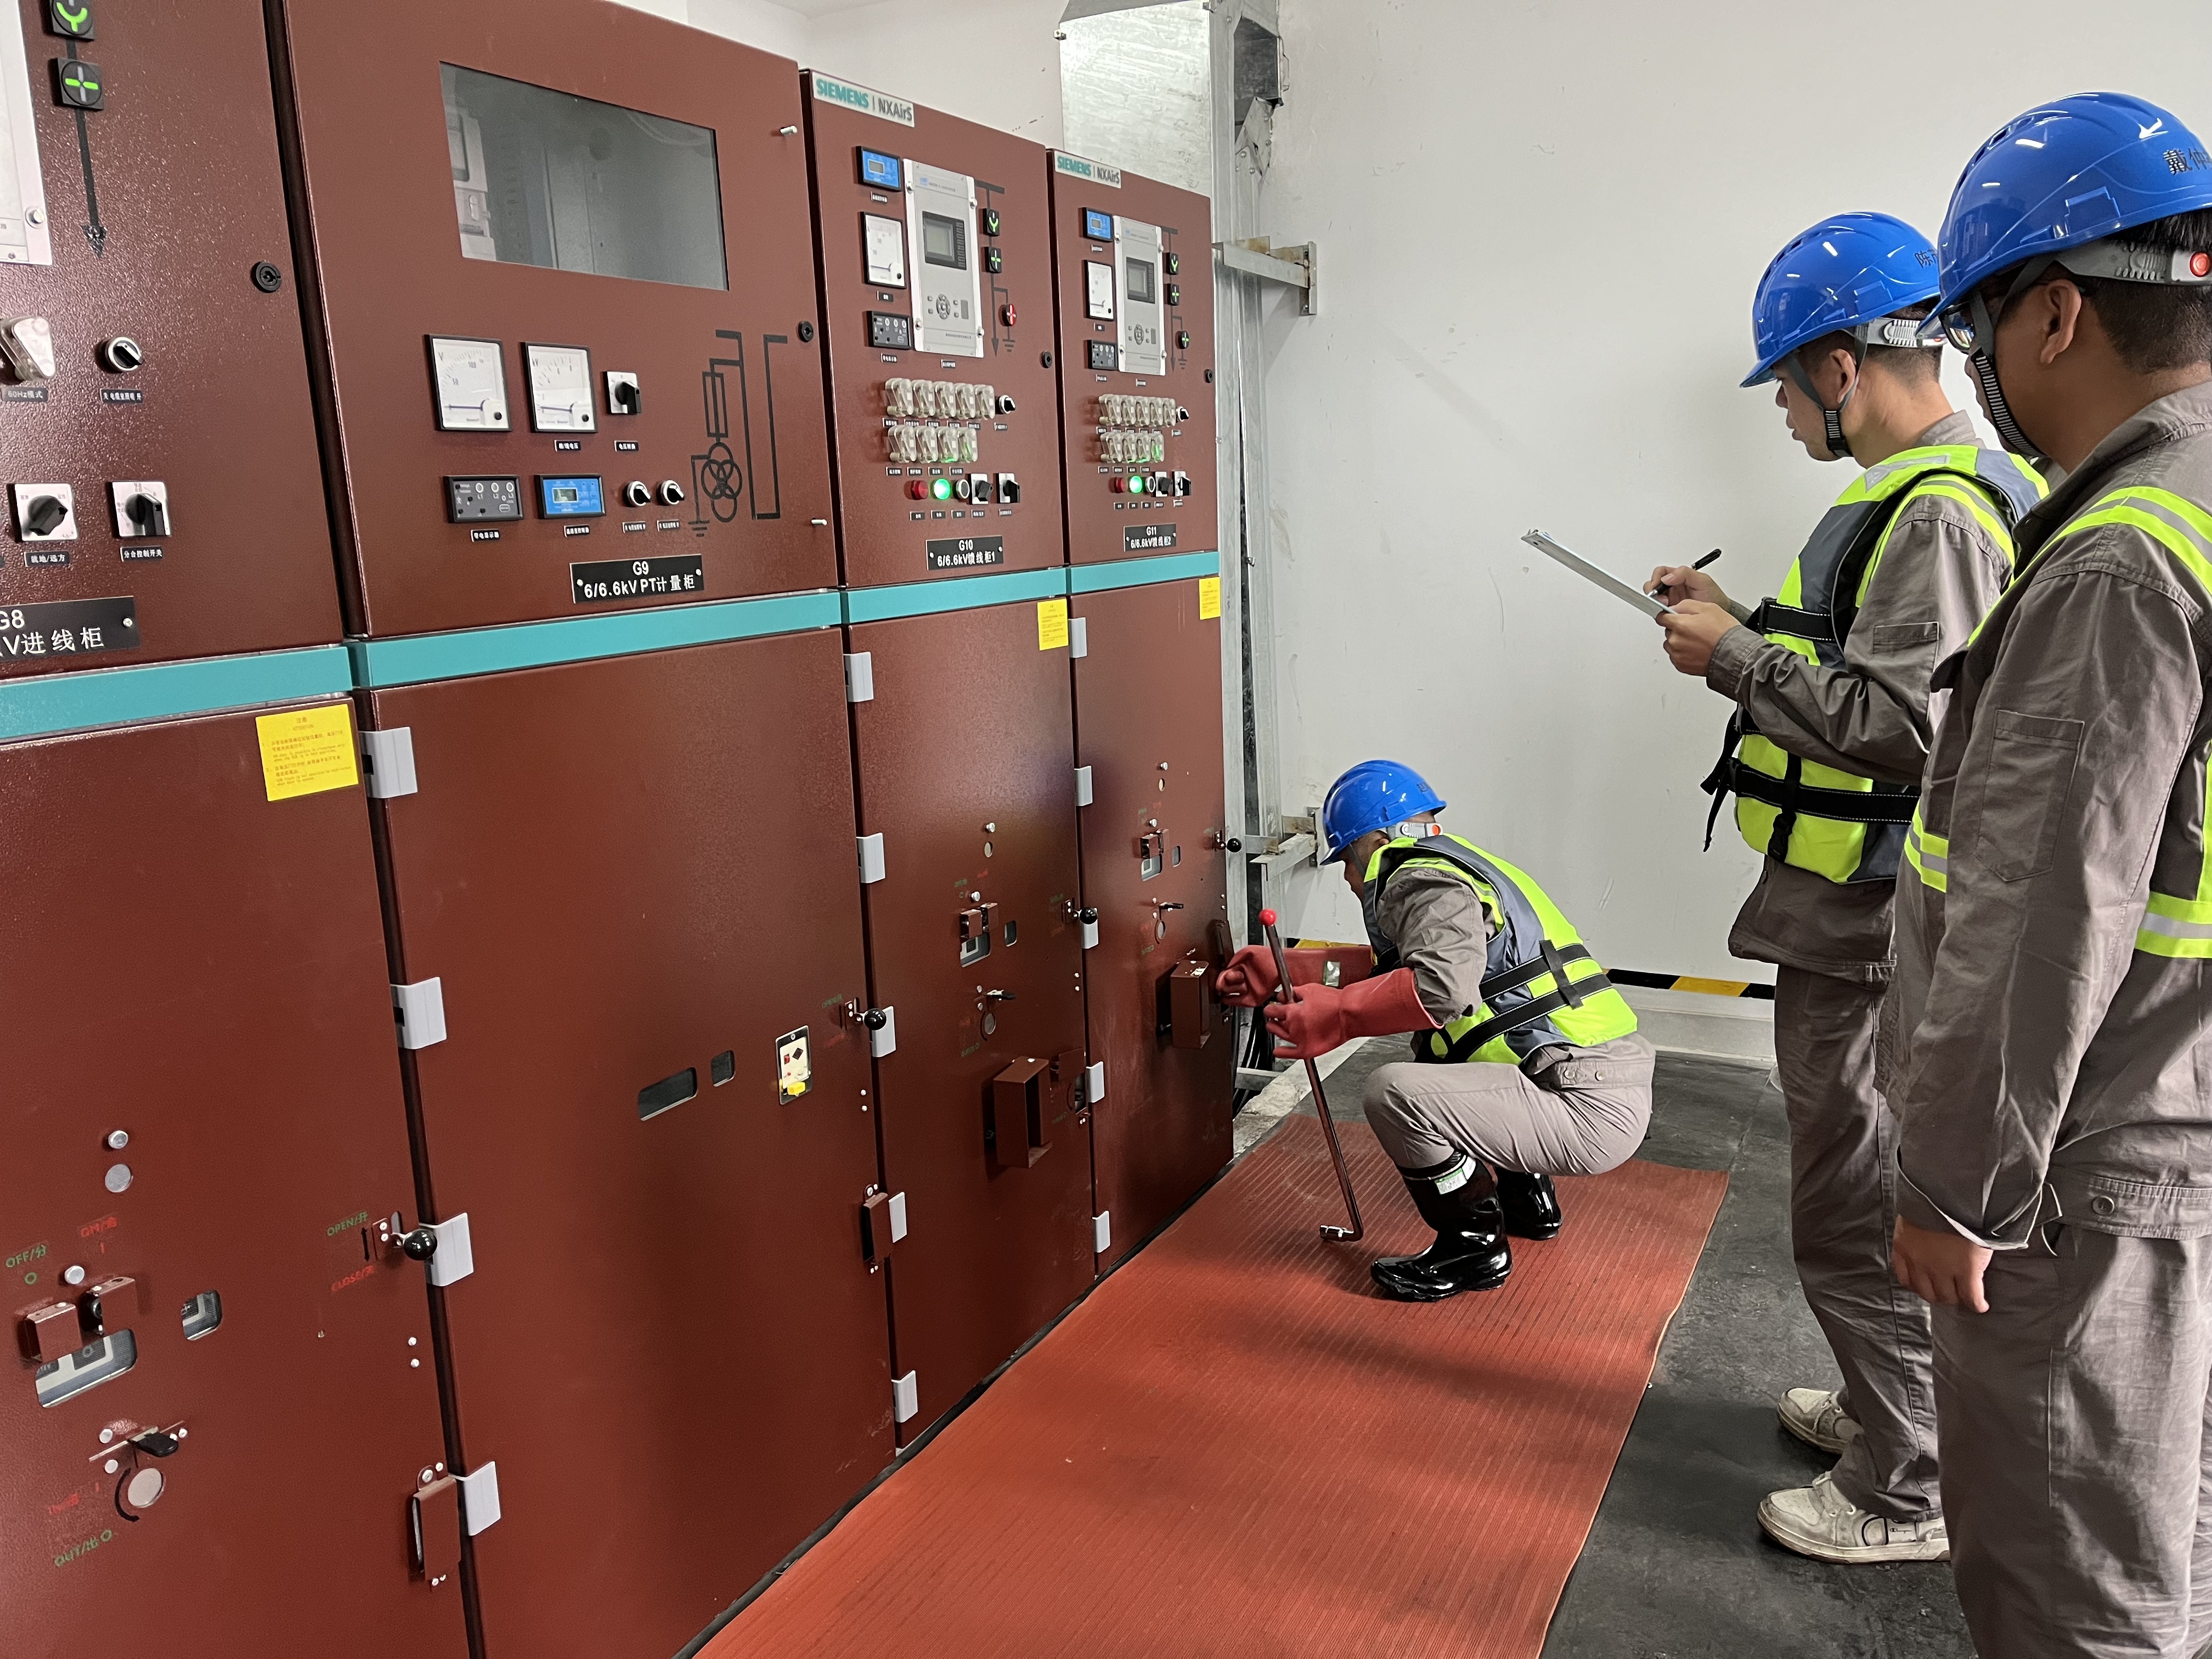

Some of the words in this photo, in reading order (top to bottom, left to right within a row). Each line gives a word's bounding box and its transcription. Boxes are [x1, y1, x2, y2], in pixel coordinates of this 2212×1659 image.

[816, 78, 869, 109] SIEMENS
[878, 97, 912, 121] NXAirS
[1057, 156, 1091, 176] SIEMENS
[1097, 166, 1120, 184] NXAirS
[2163, 148, 2212, 175] 戴仲
[1146, 526, 1156, 535] G11
[958, 539, 973, 551] G10
[633, 561, 649, 575] G9
